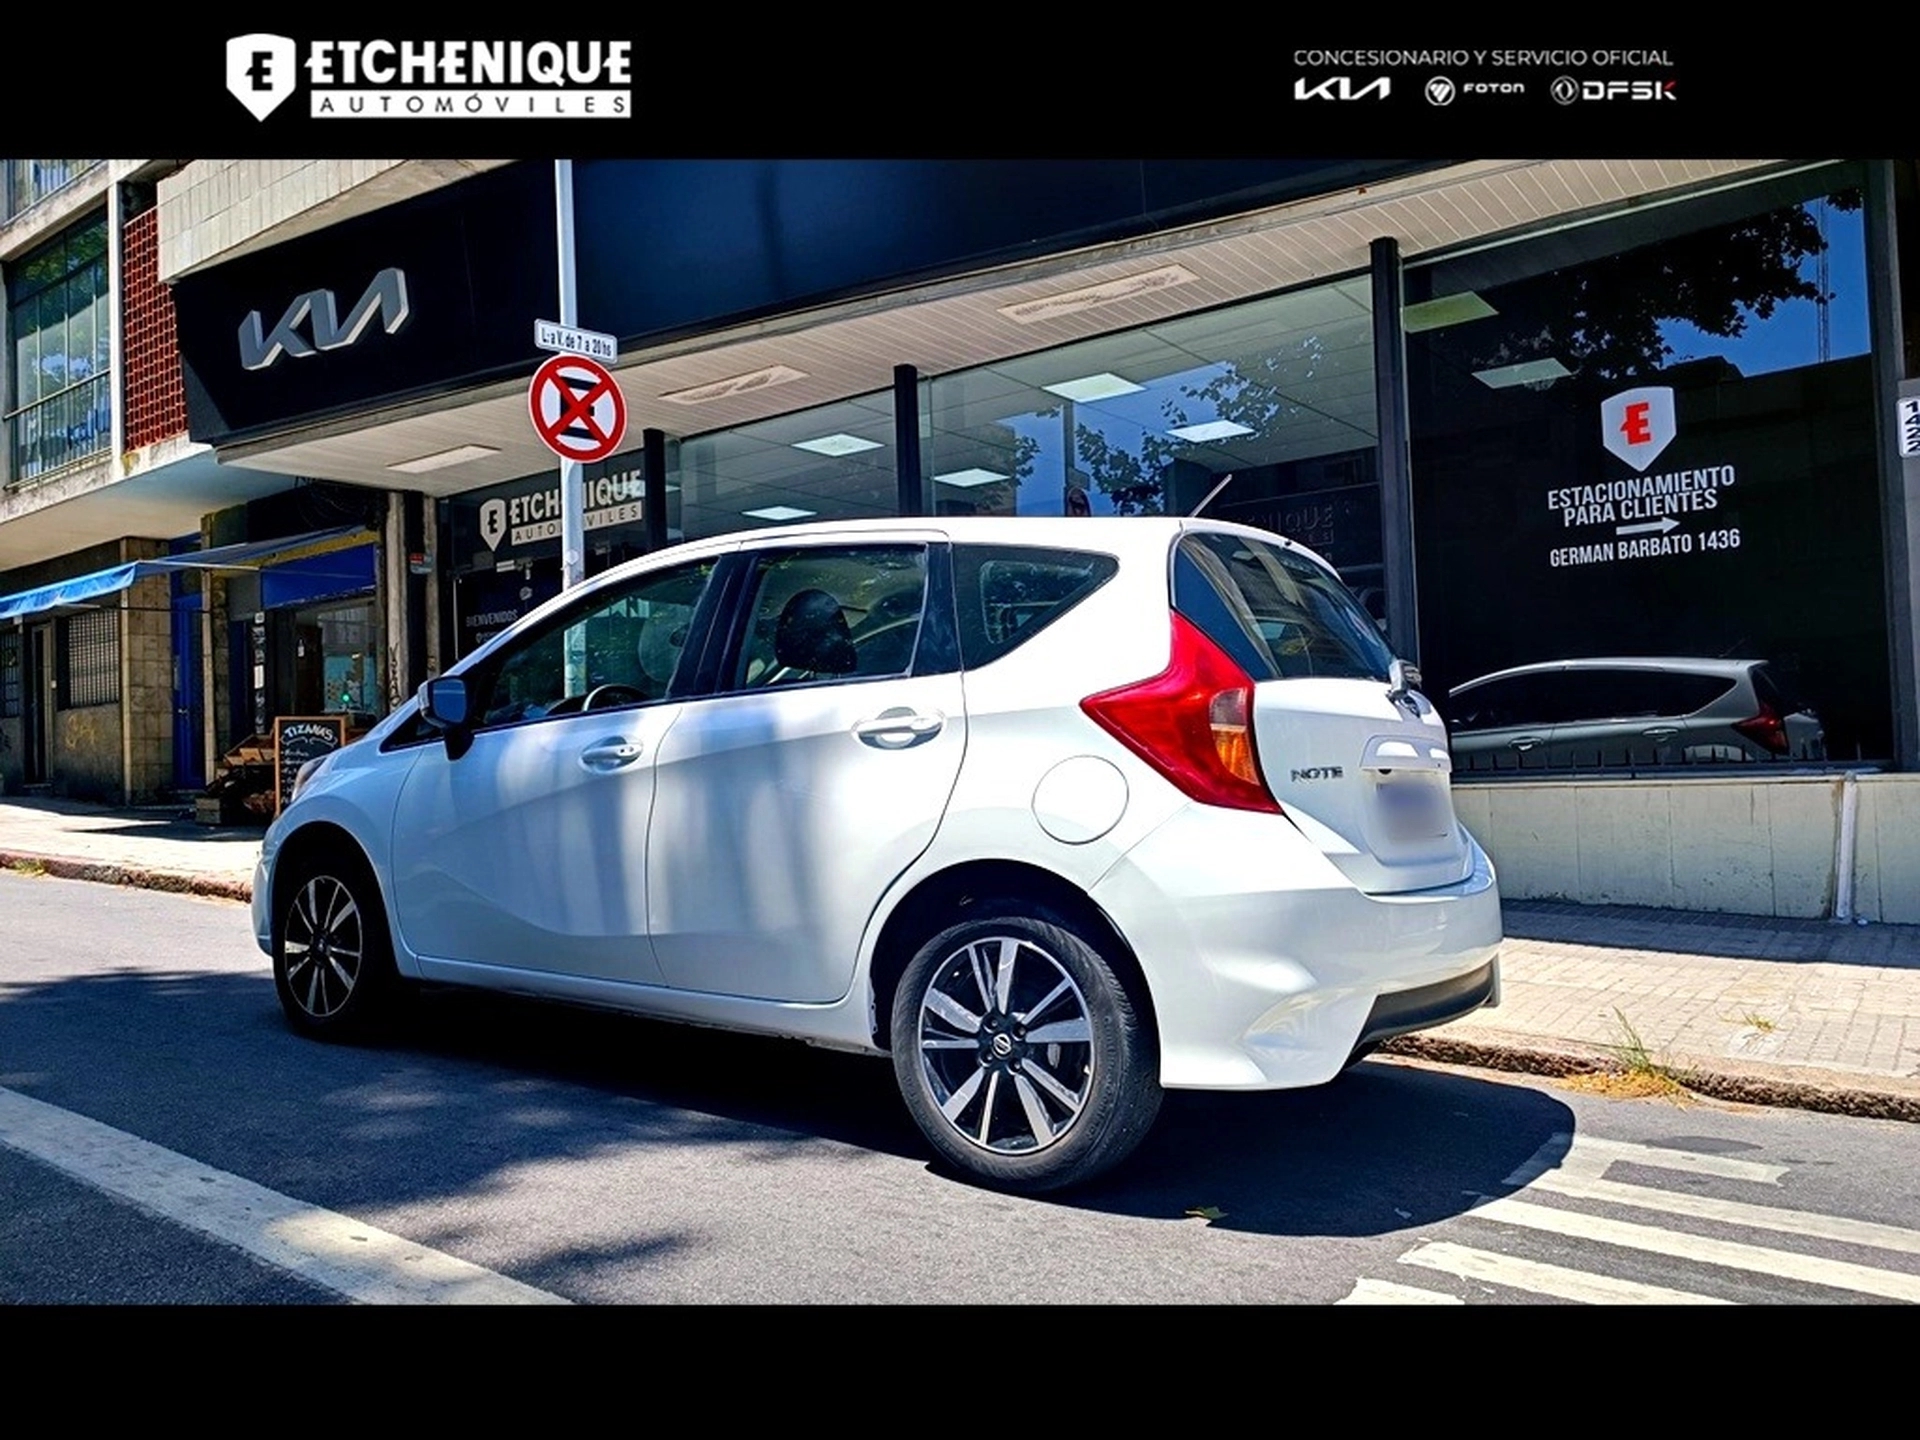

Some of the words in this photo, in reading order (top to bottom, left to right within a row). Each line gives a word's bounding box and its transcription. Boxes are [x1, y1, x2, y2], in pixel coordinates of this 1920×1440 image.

[238, 267, 409, 370] KIA
[509, 470, 643, 525] ETCHIQUE
[1548, 464, 1736, 510] ESTACIONAMIENTO
[514, 505, 638, 541] AUTOVILES
[1564, 502, 1615, 527] PARA
[1620, 488, 1718, 520] CLIENTES
[1550, 543, 1614, 567] GERMAN
[1618, 534, 1692, 559] BARBATO
[1698, 528, 1741, 551] 1436
[1290, 766, 1343, 782] NOTE
